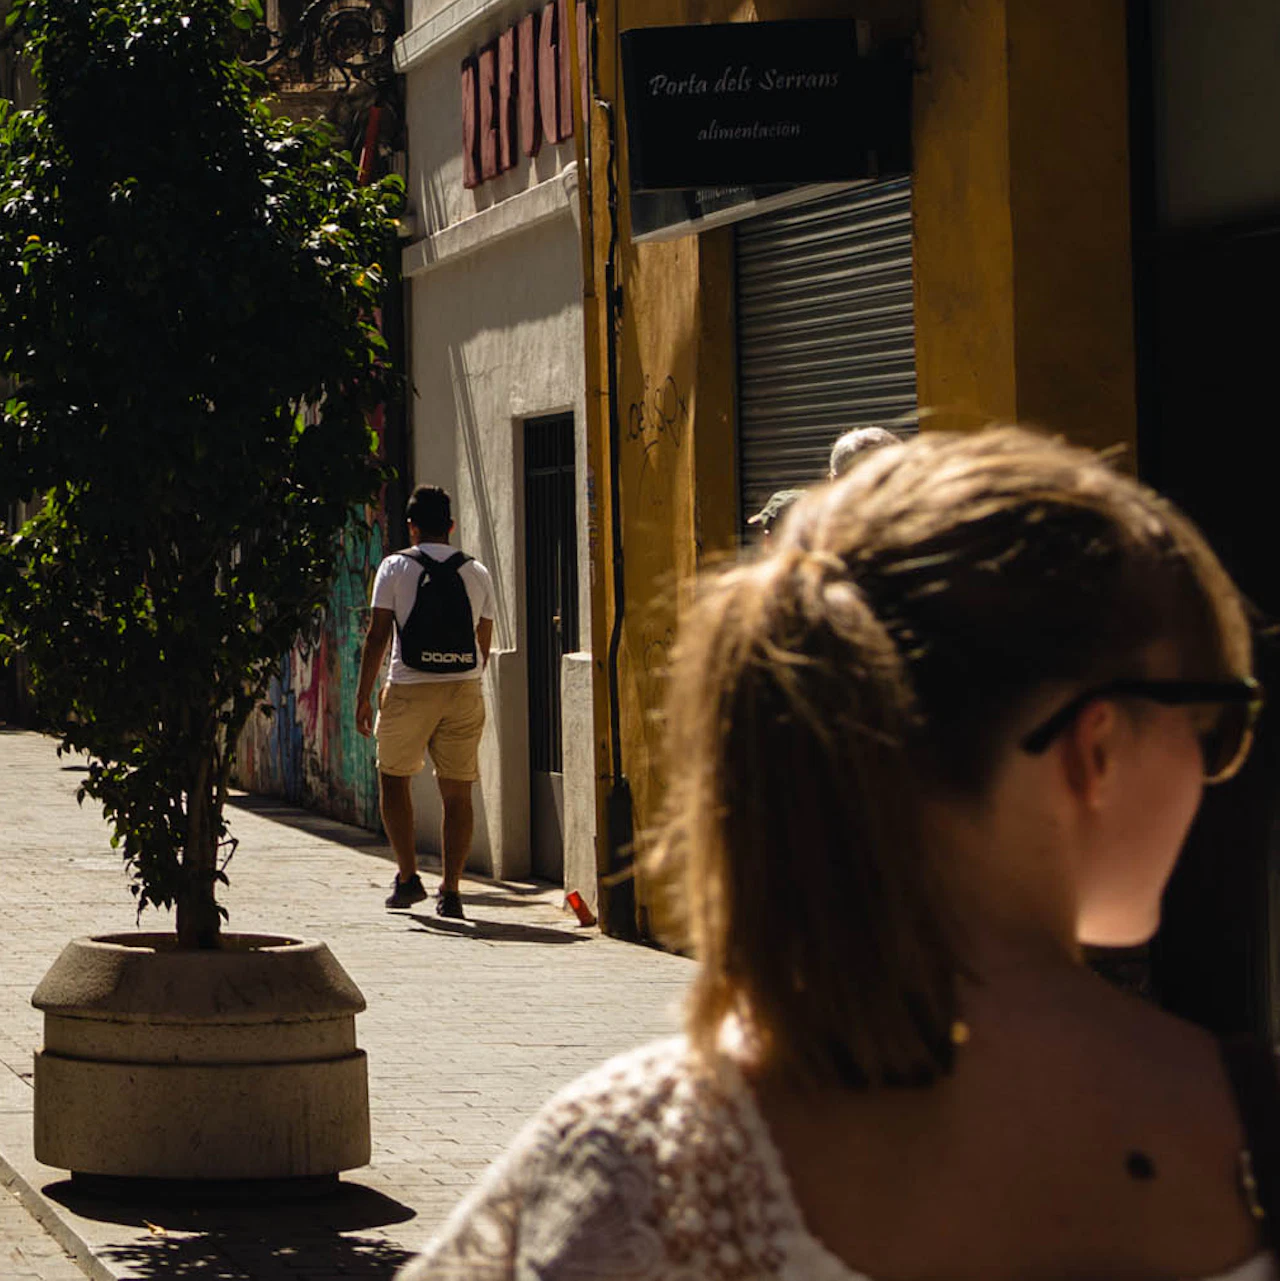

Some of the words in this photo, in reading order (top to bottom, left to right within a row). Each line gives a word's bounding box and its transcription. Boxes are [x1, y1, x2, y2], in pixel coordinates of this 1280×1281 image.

[648, 73, 708, 96] Porta
[714, 65, 752, 93] dels
[758, 68, 839, 91] Serrans
